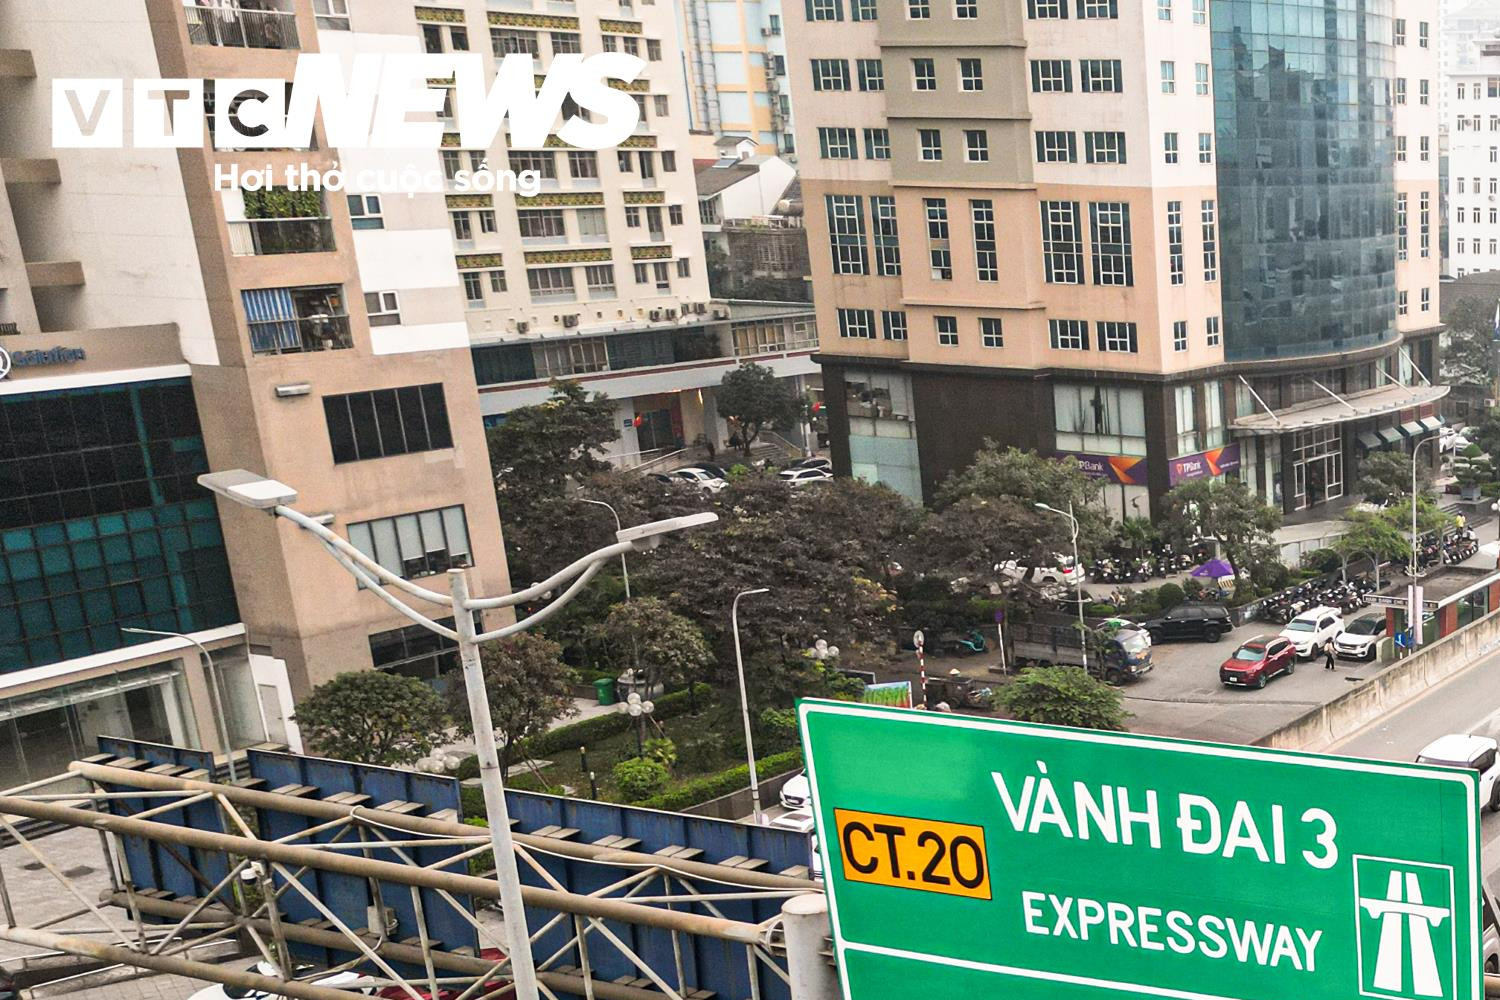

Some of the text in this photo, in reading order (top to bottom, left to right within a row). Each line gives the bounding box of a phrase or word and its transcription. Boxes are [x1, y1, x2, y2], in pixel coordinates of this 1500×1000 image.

[843, 821, 984, 889] CT.20
[992, 760, 1339, 869] VÀNH ĐAI 3
[1022, 890, 1323, 972] EXPRESSWAY
